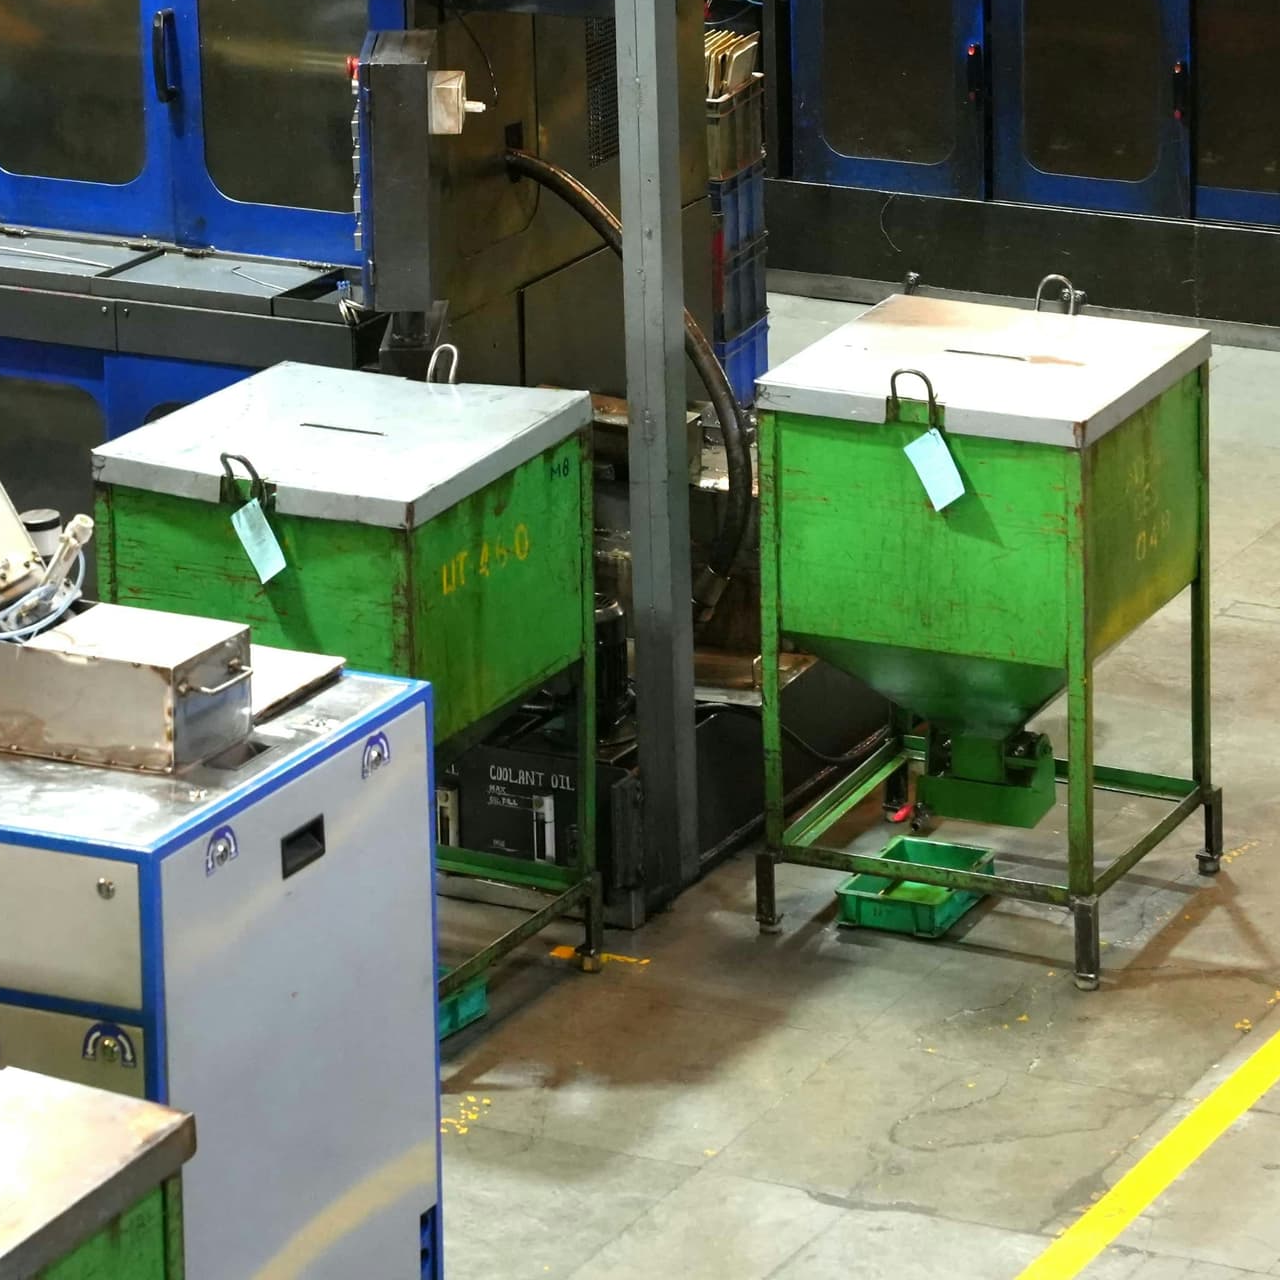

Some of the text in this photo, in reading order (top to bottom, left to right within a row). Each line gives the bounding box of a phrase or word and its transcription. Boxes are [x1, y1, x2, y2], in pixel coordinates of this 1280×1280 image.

[489, 764, 576, 792] COOLANT OIL
[489, 785, 506, 793] MAX
